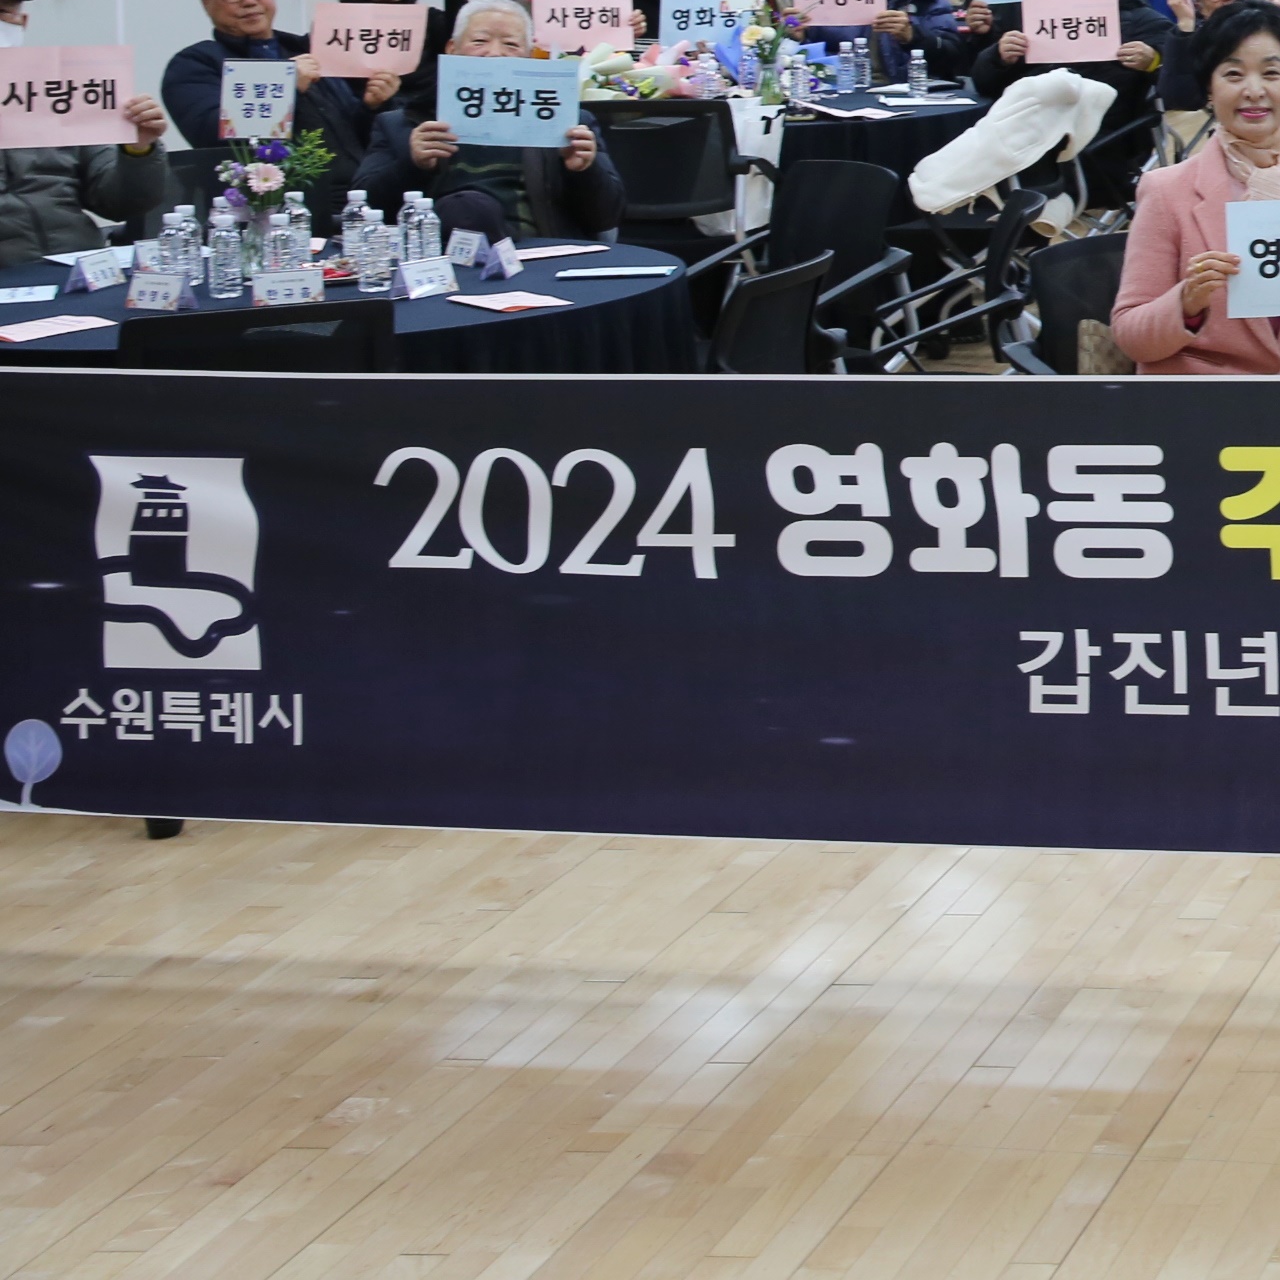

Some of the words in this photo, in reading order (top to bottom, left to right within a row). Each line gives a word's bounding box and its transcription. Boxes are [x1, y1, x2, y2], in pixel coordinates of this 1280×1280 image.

[547, 7, 619, 29] 사랑해
[1036, 17, 1106, 40] 사랑해
[326, 29, 411, 54] 사랑해
[2, 79, 116, 114] 사랑해
[232, 82, 247, 98] 동
[253, 82, 284, 98] 발전
[241, 102, 273, 118] 공헌
[456, 87, 561, 120] 영화동
[374, 447, 735, 579] 2024
[766, 442, 1174, 578] 영화동
[61, 689, 302, 745] 수원특례시
